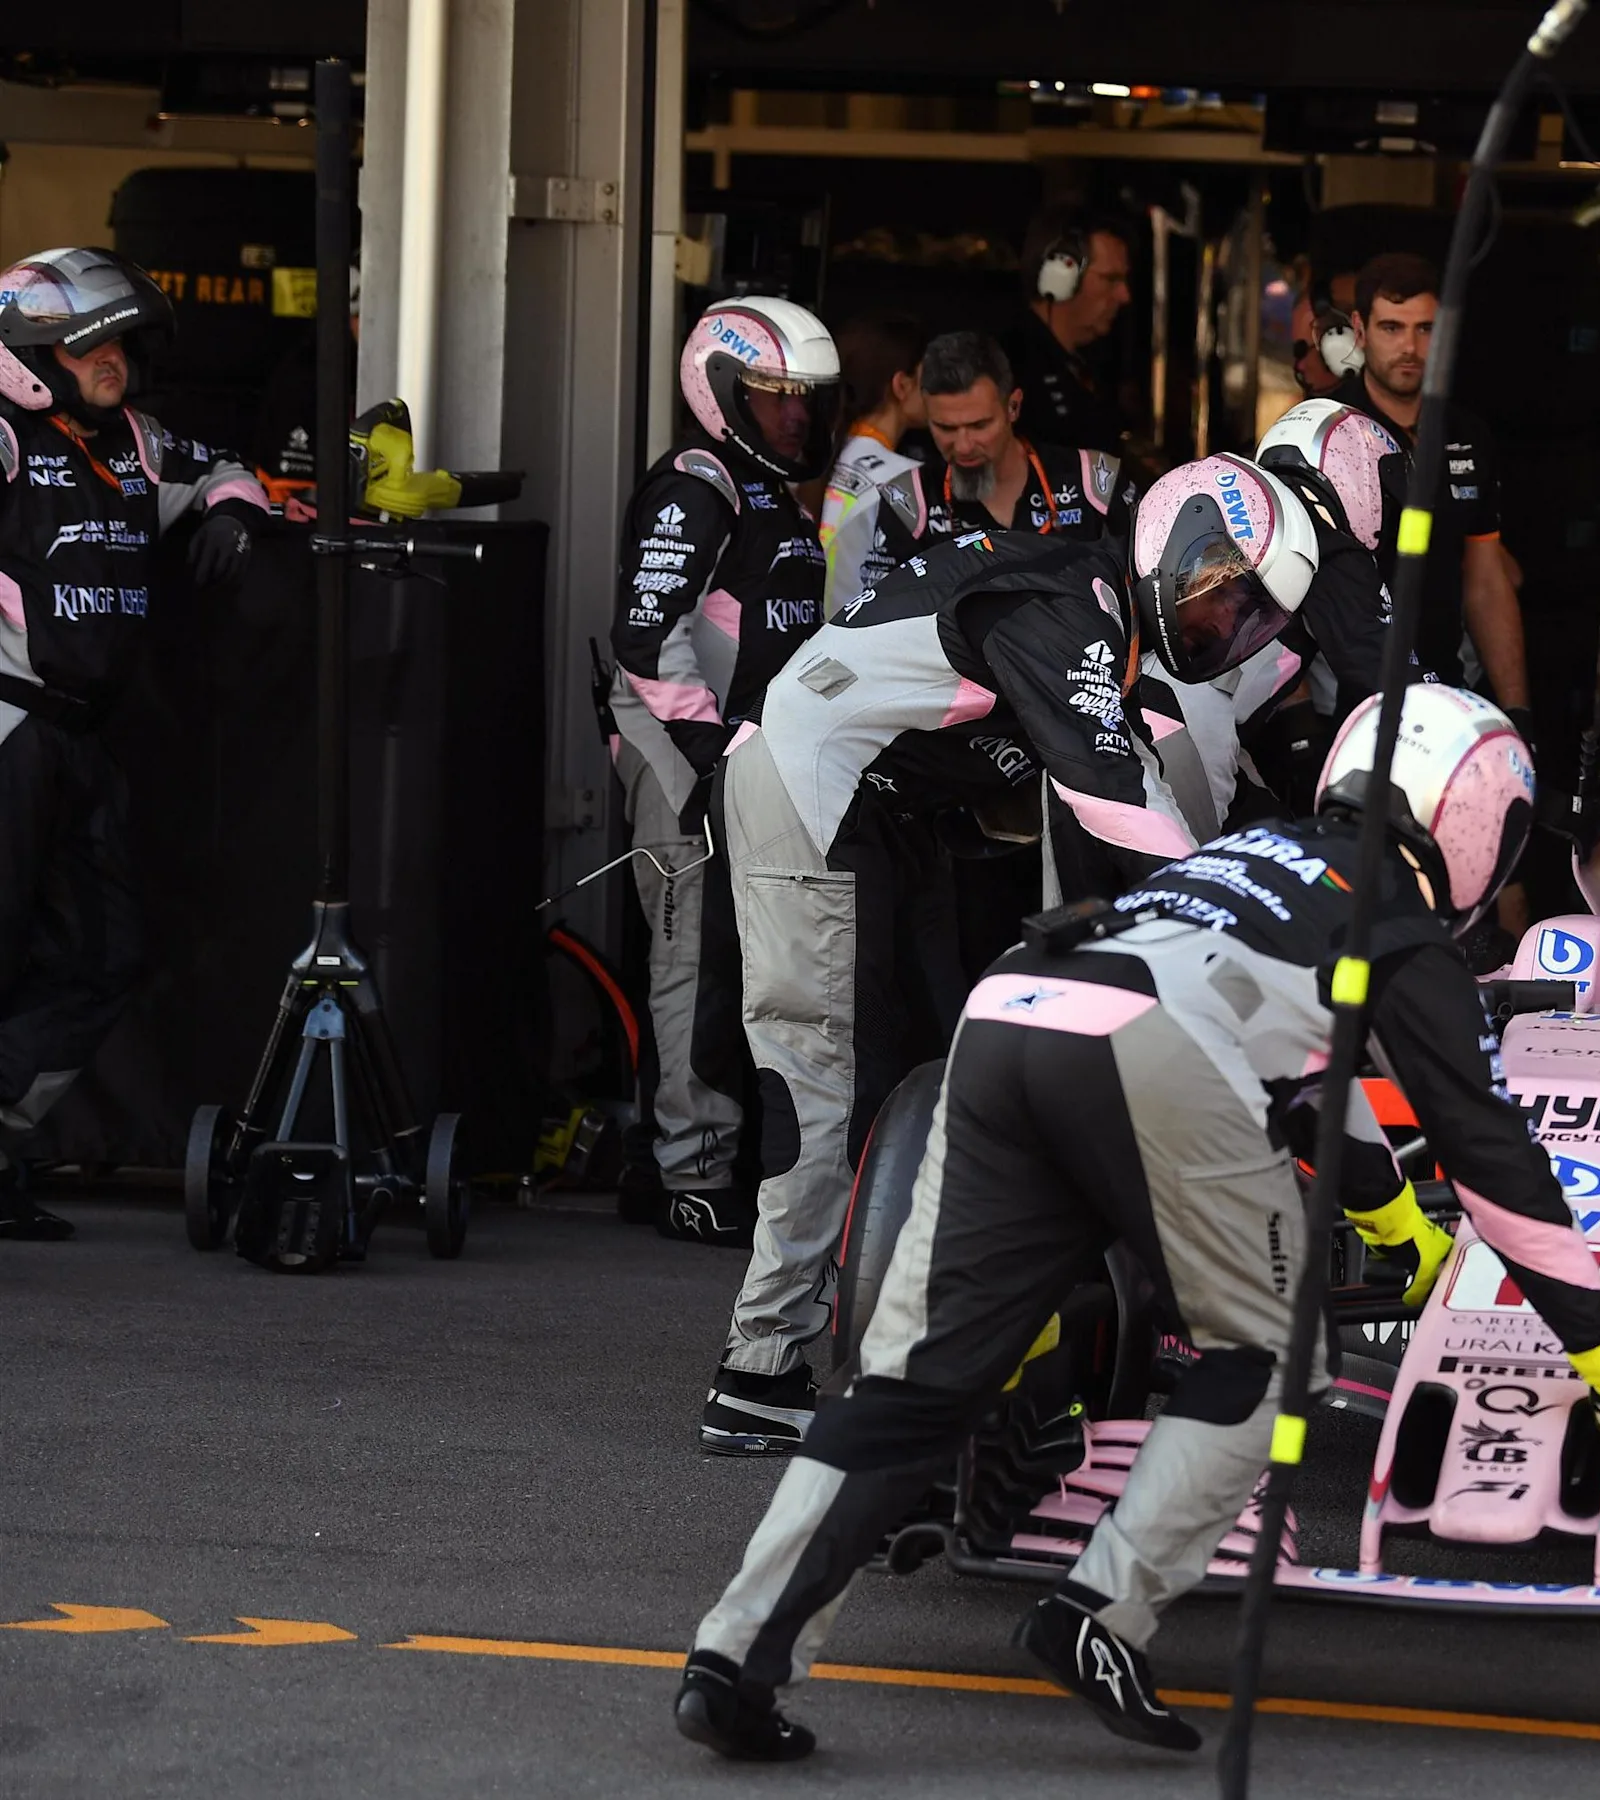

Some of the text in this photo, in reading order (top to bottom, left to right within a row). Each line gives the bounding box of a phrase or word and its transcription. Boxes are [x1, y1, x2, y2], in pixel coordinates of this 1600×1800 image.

[196, 276, 264, 304] REAR
[719, 328, 761, 365] BWT
[28, 468, 77, 488] NEC
[1220, 487, 1255, 541] BWT
[653, 522, 683, 537] INTER
[639, 537, 697, 554] infinitum
[641, 551, 688, 567] HYPE
[629, 607, 665, 623] FXTM
[1451, 1315, 1544, 1329] CARTE
[1462, 1464, 1525, 1473] GROUP
